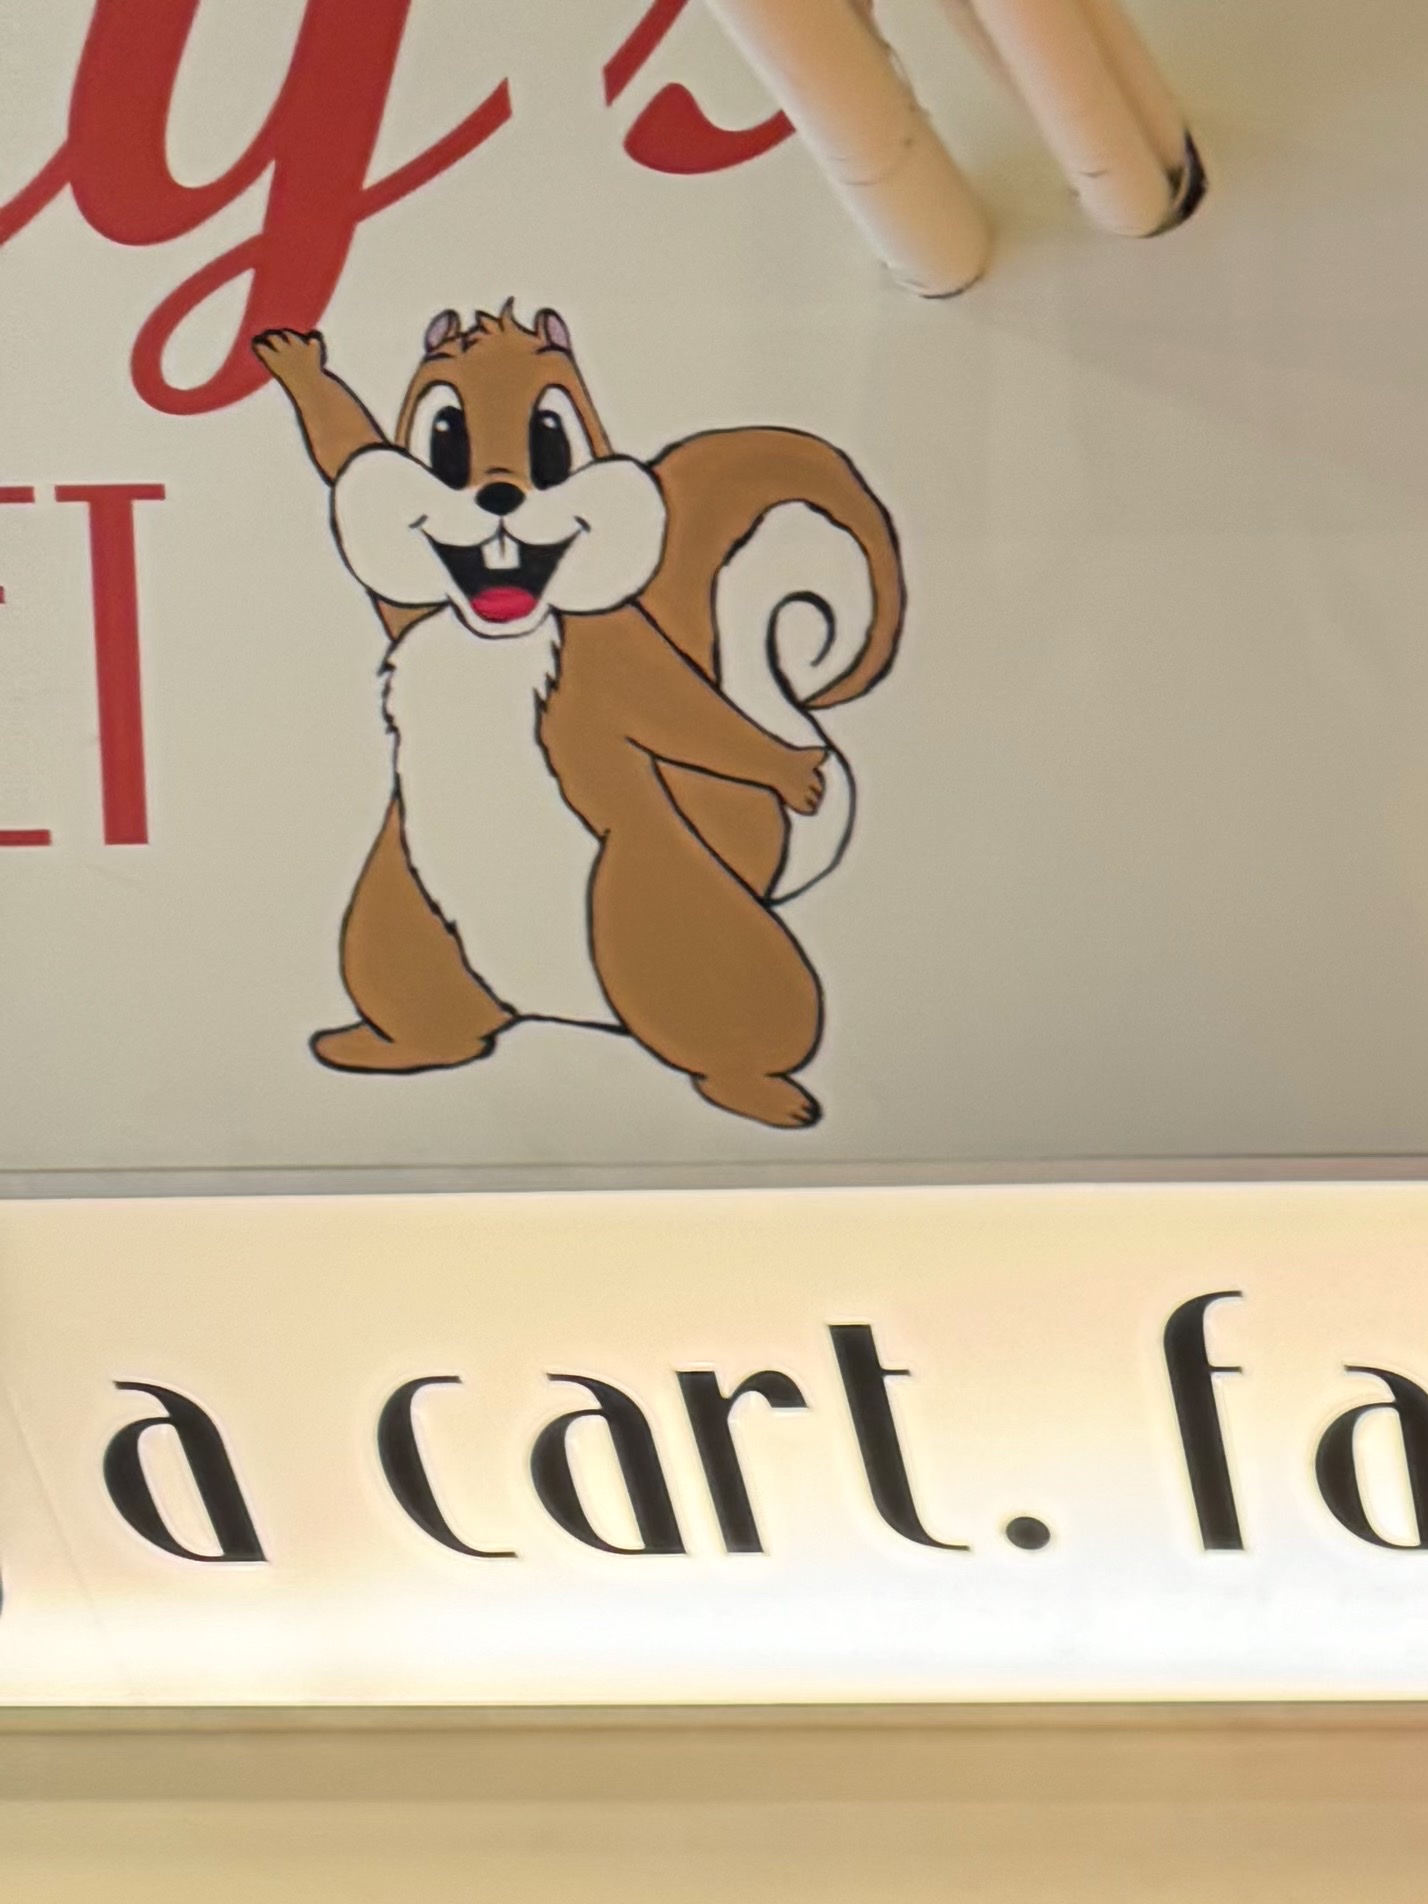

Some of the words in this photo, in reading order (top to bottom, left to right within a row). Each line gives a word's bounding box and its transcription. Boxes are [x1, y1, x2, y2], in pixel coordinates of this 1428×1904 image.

[0, 484, 165, 846] T
[101, 1379, 268, 1563] a
[375, 1322, 1051, 1558] cart.
